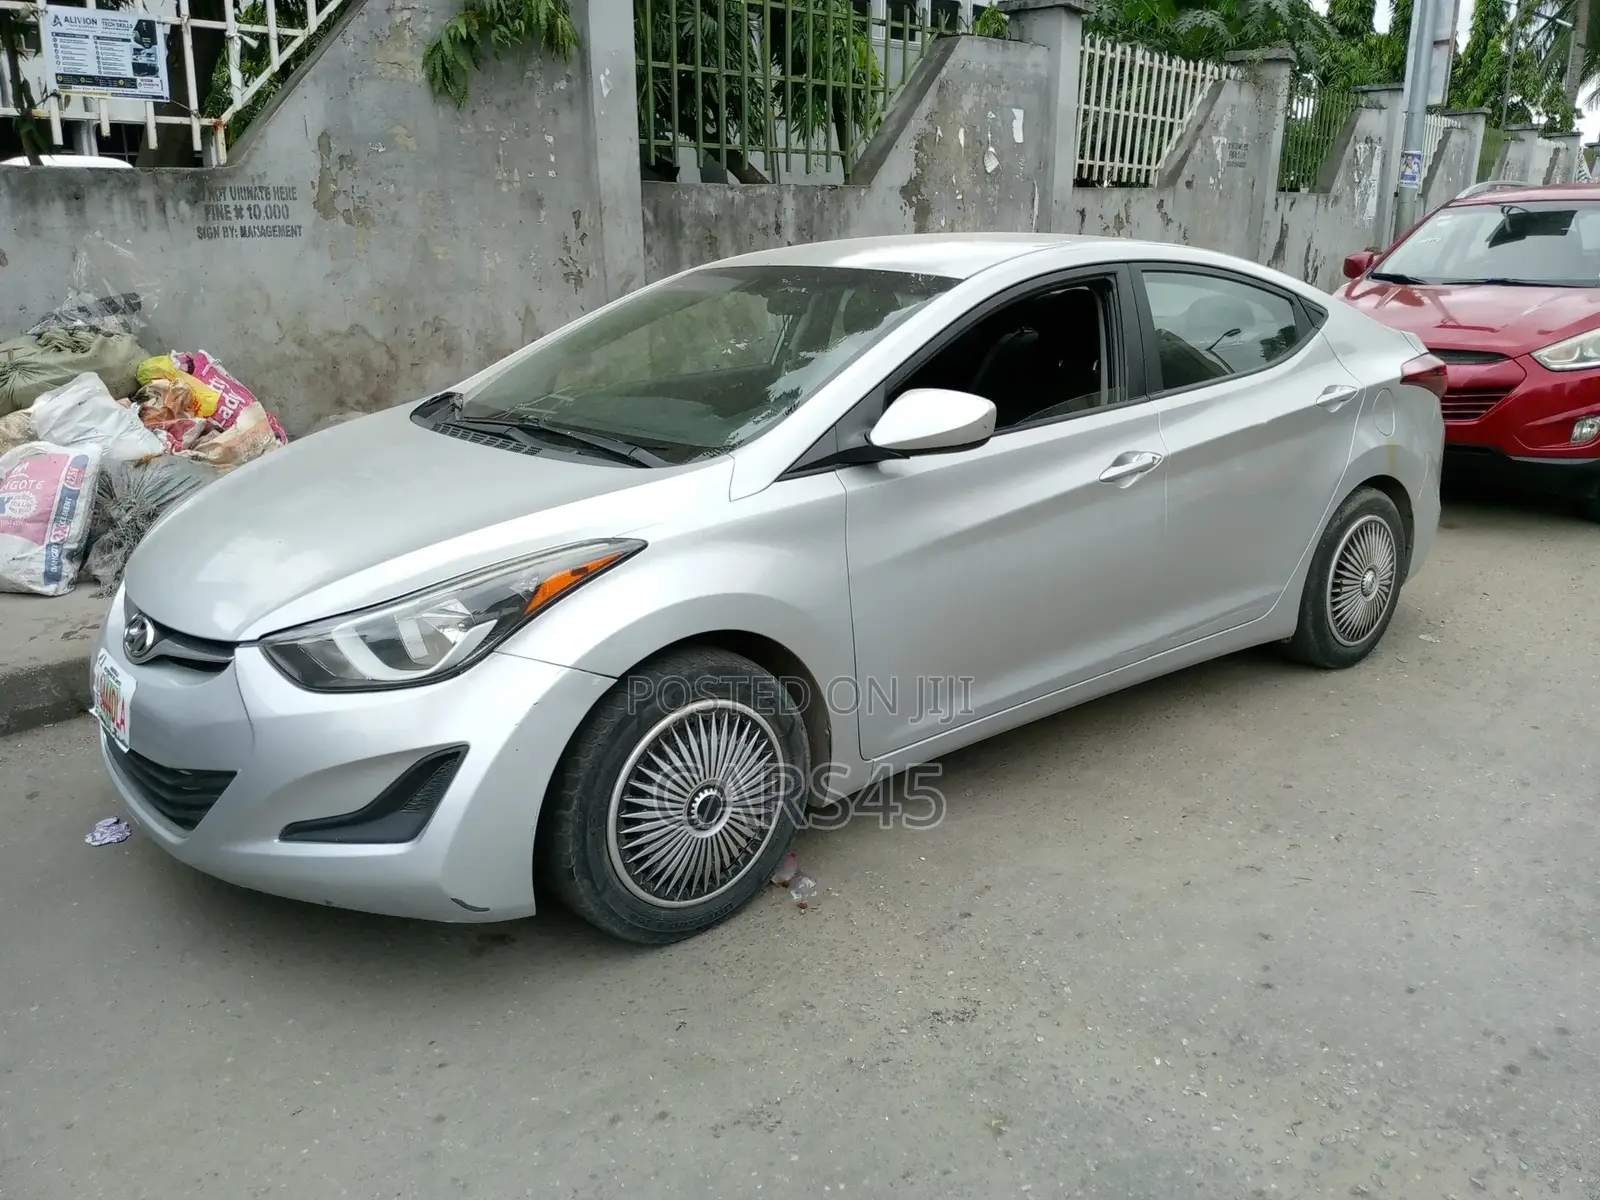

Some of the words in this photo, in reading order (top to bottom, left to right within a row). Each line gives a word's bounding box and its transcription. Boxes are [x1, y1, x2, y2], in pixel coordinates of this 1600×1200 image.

[64, 16, 98, 26] ALIVION
[229, 185, 271, 201] URINATE
[273, 186, 298, 201] HERE
[204, 204, 232, 221] FINE
[196, 226, 220, 240] SIGN
[240, 225, 302, 238] MANAGEMENT
[207, 389, 246, 427] Lady
[60, 496, 73, 525] CEMENT
